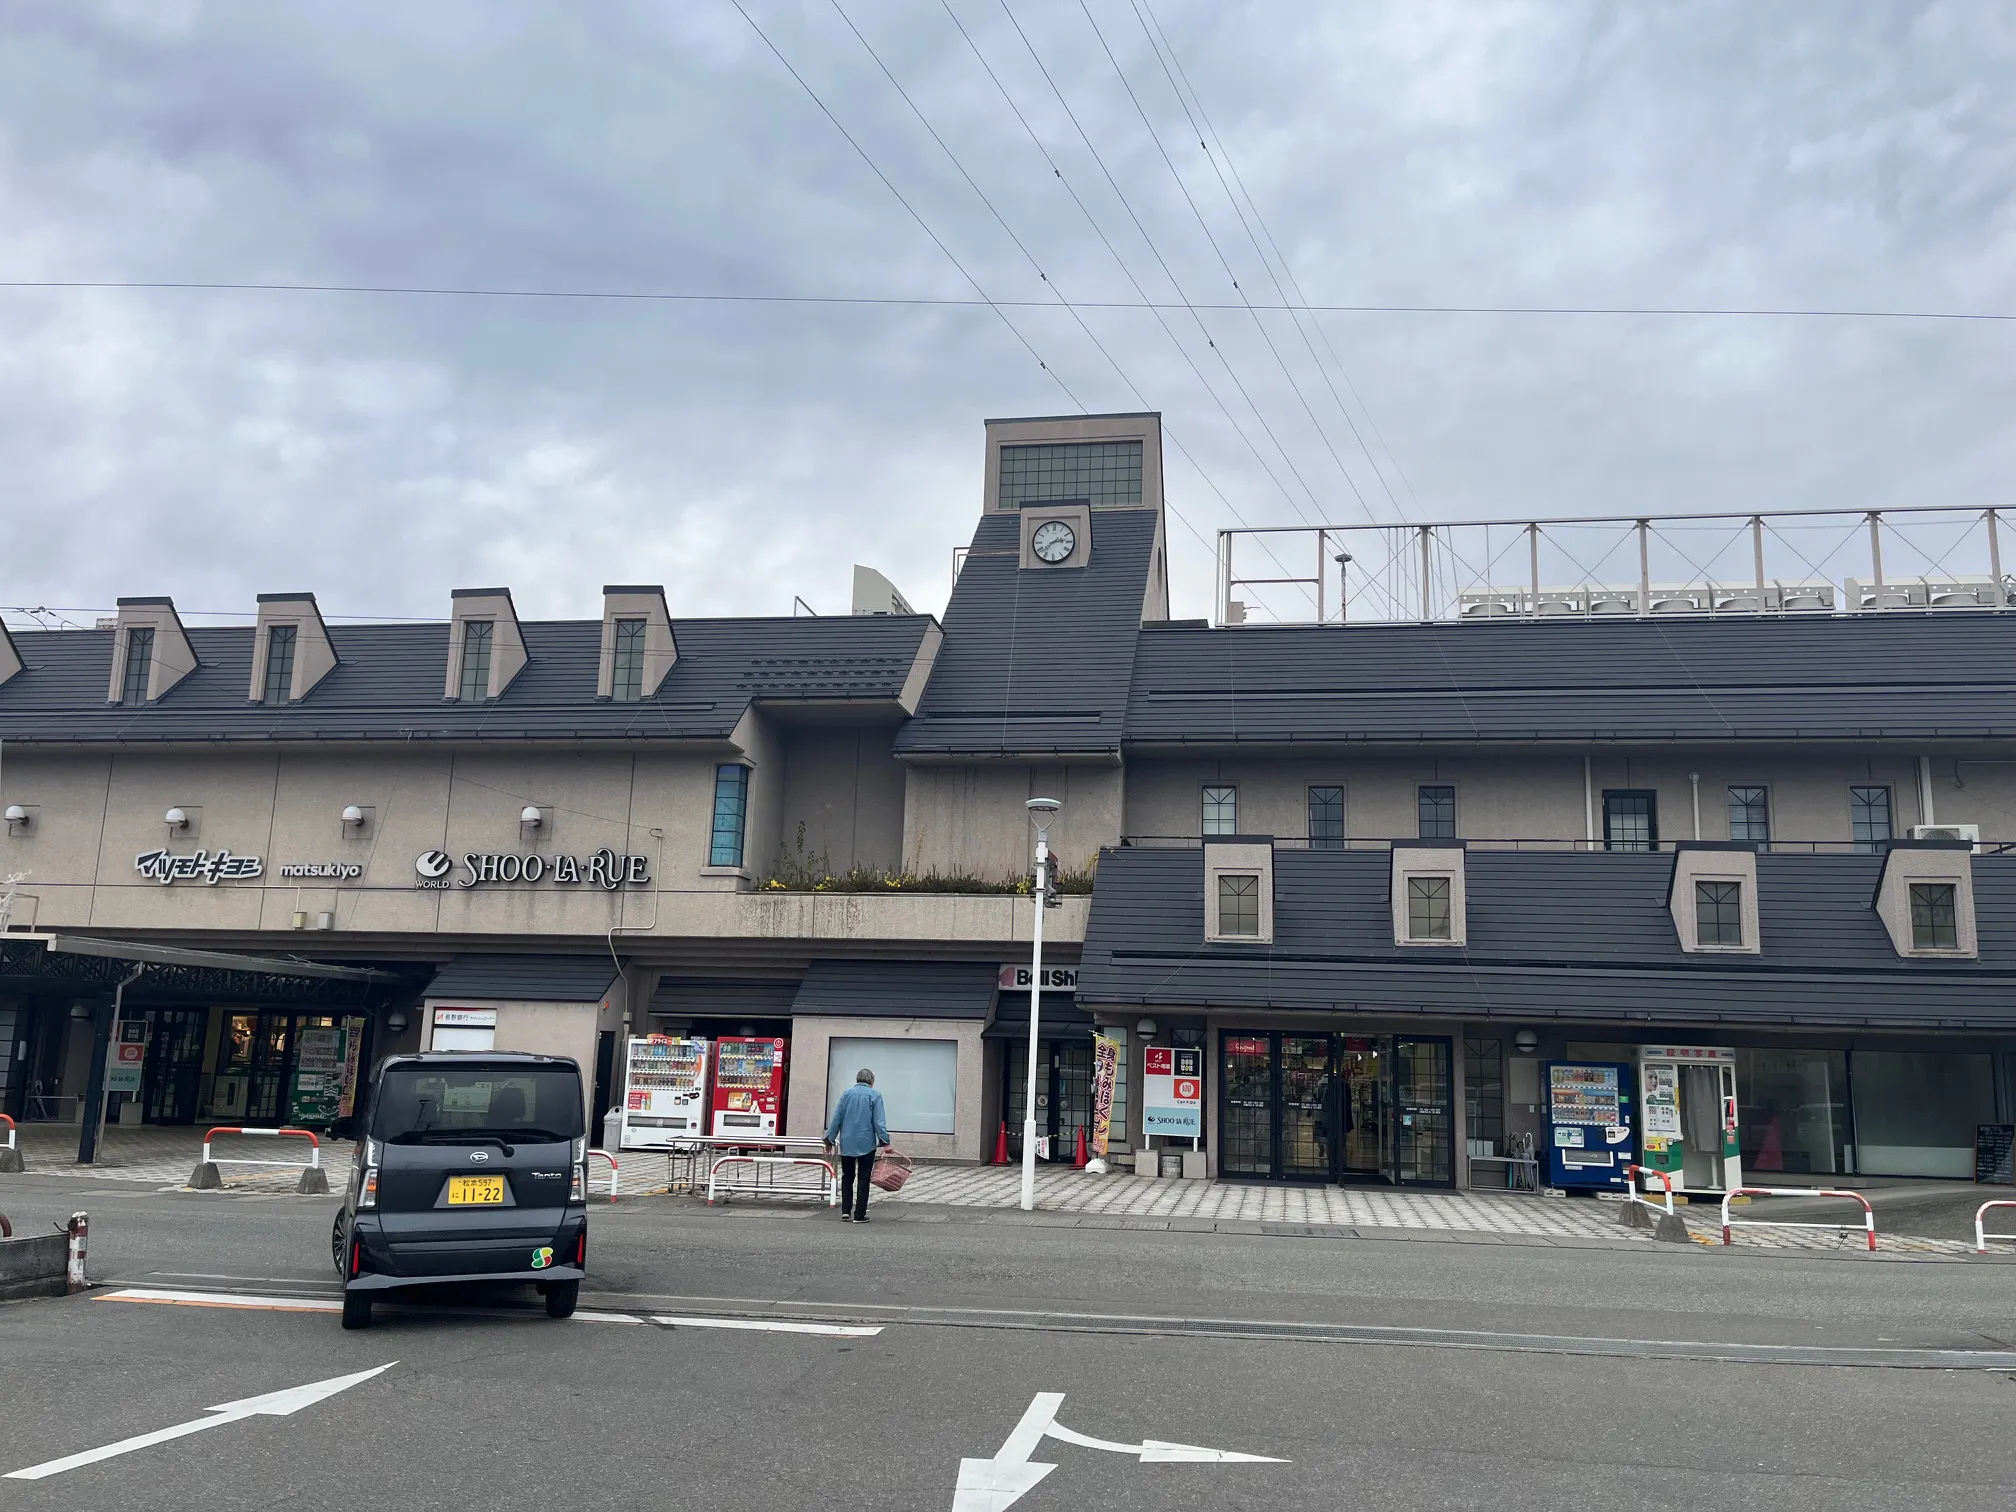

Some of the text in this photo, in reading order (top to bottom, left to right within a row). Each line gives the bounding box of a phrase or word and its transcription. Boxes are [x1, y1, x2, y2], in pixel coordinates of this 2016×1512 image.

[136, 850, 262, 884] マツモトキヨシ
[279, 863, 361, 880] matsukiyo
[415, 880, 450, 889] WORLD
[462, 1179, 492, 1187] 松本 597
[463, 1187, 500, 1201] 11-22
